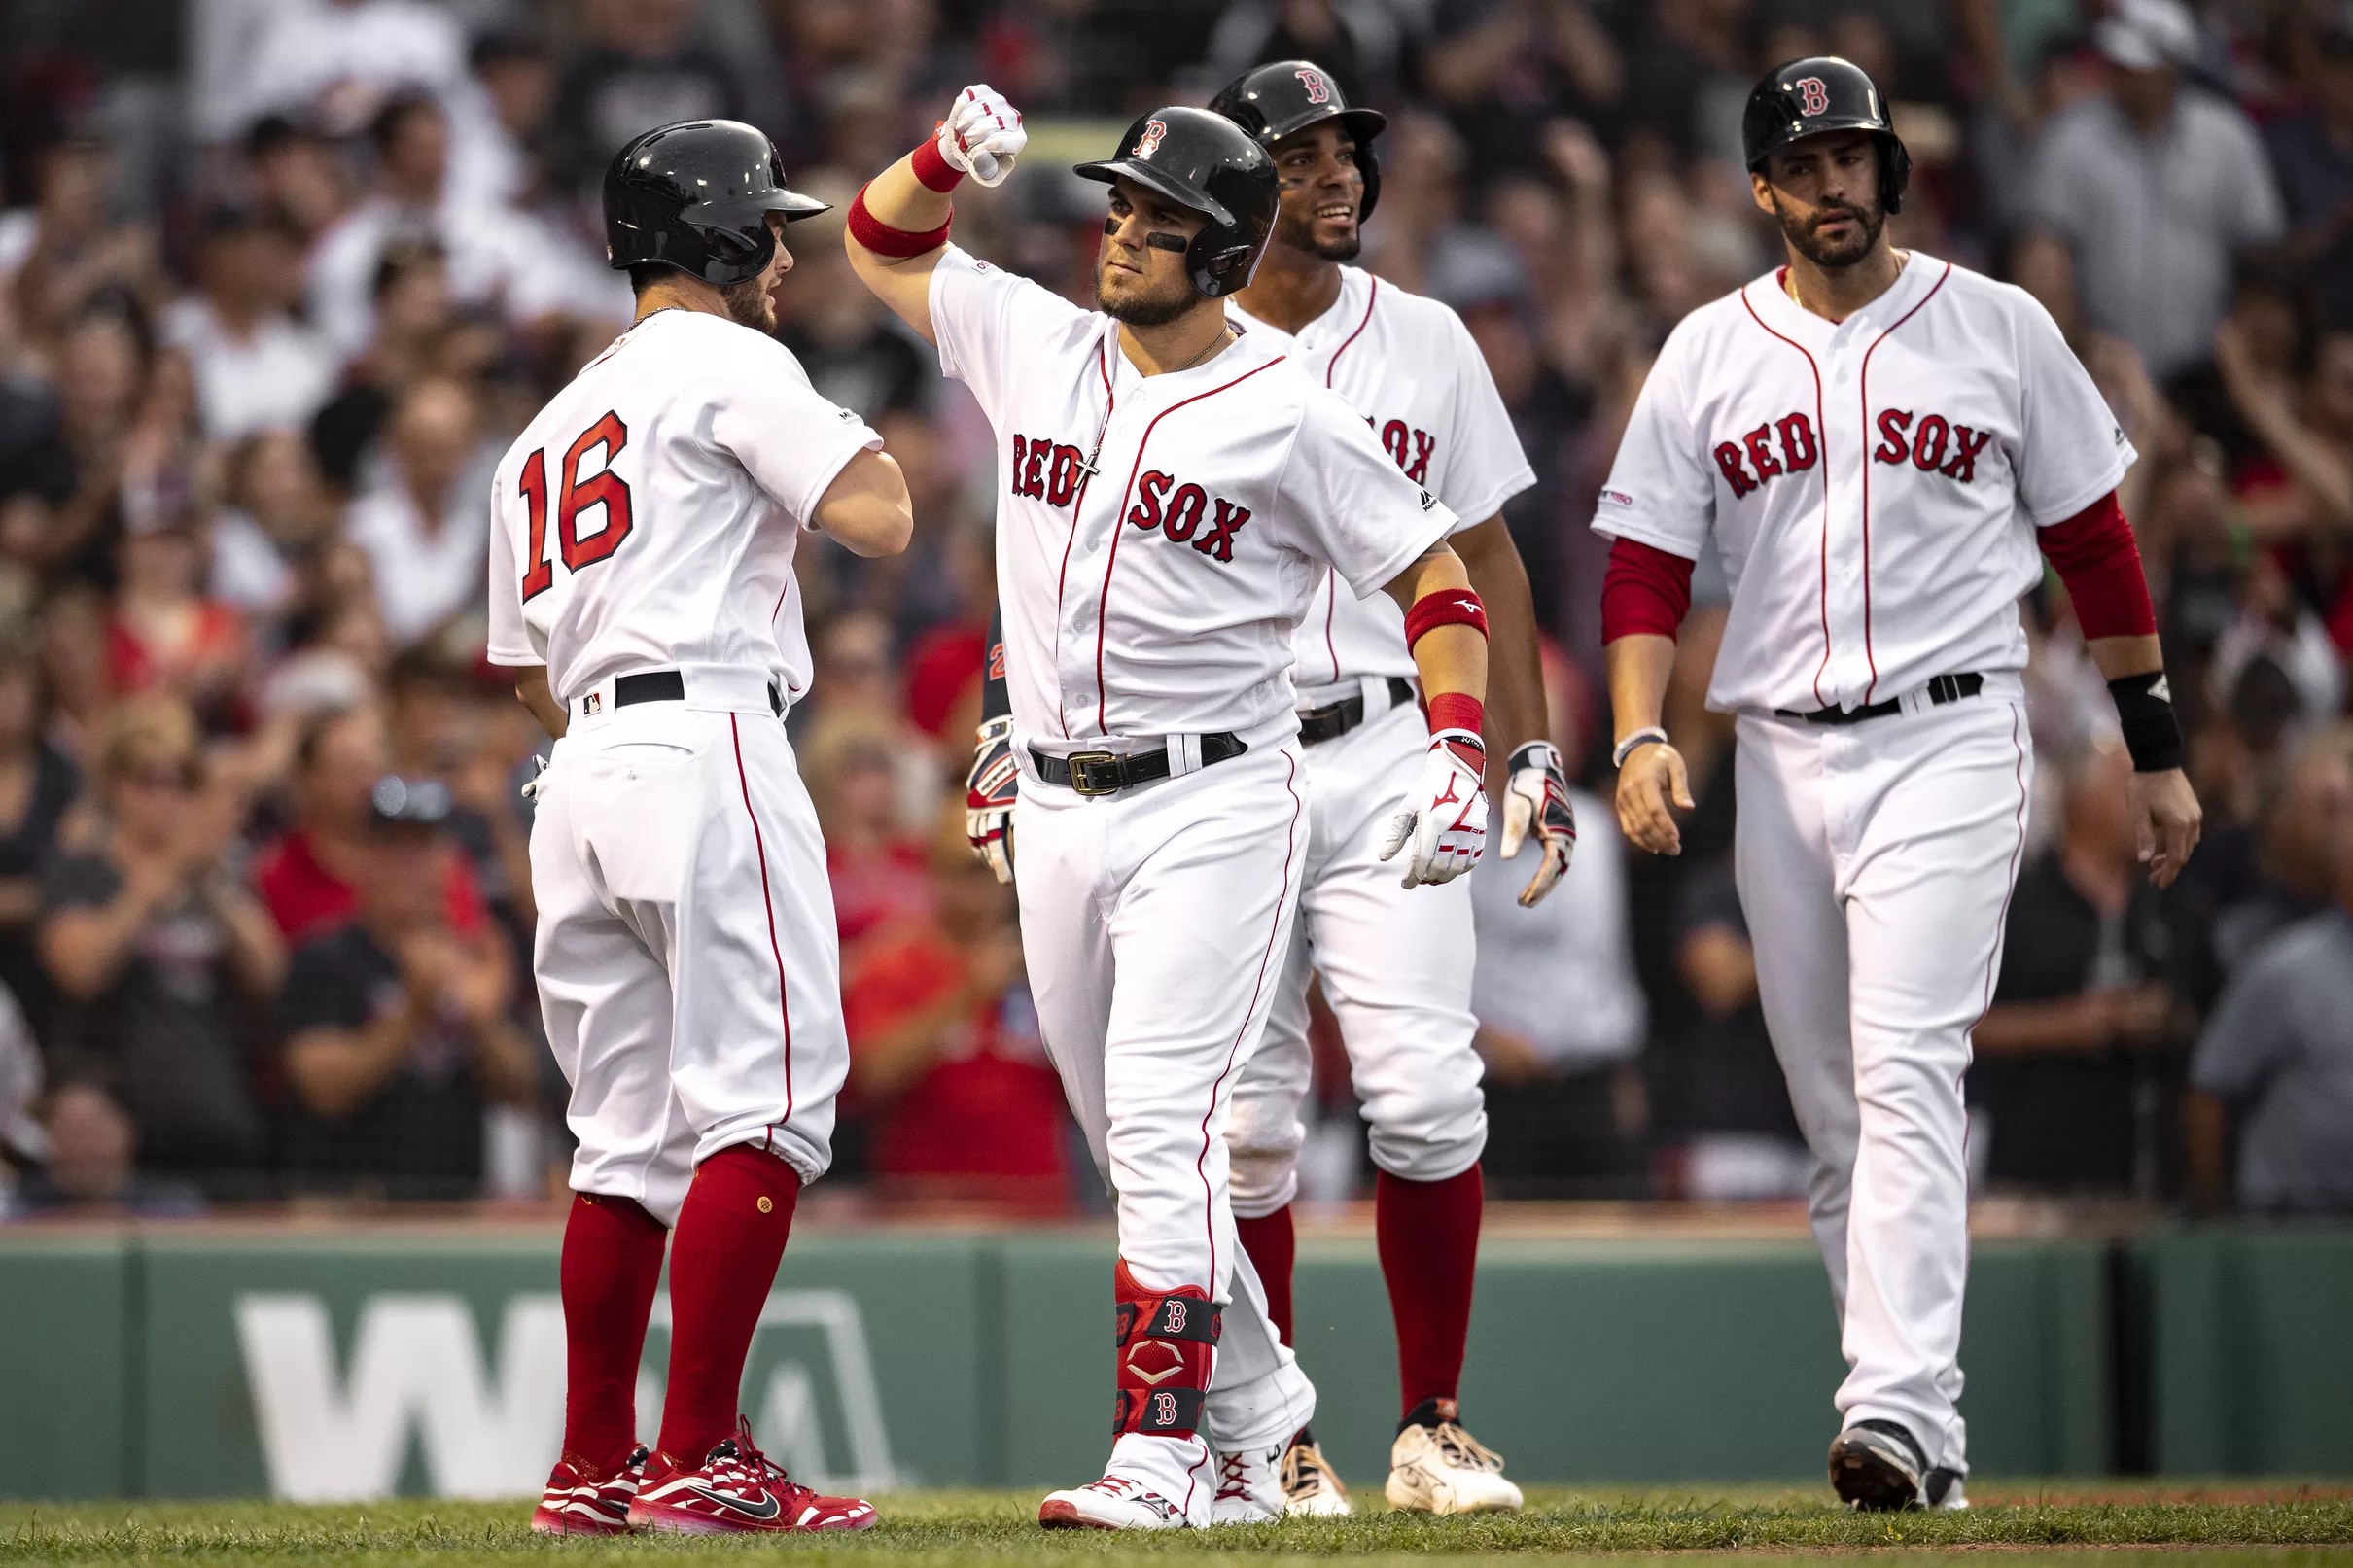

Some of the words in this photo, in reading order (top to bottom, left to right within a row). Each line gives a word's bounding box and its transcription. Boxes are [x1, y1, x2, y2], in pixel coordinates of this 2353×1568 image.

[1294, 69, 1329, 104] B
[1796, 77, 1829, 117] B
[1132, 119, 1167, 160] B
[1364, 415, 1435, 486] OX
[1713, 412, 1817, 500] RED
[1874, 408, 1991, 483] SOX
[519, 409, 633, 606] 16
[1012, 434, 1084, 507] RED
[1128, 470, 1251, 563] SOX
[1164, 1300, 1187, 1333] B
[1154, 1392, 1177, 1425] B
